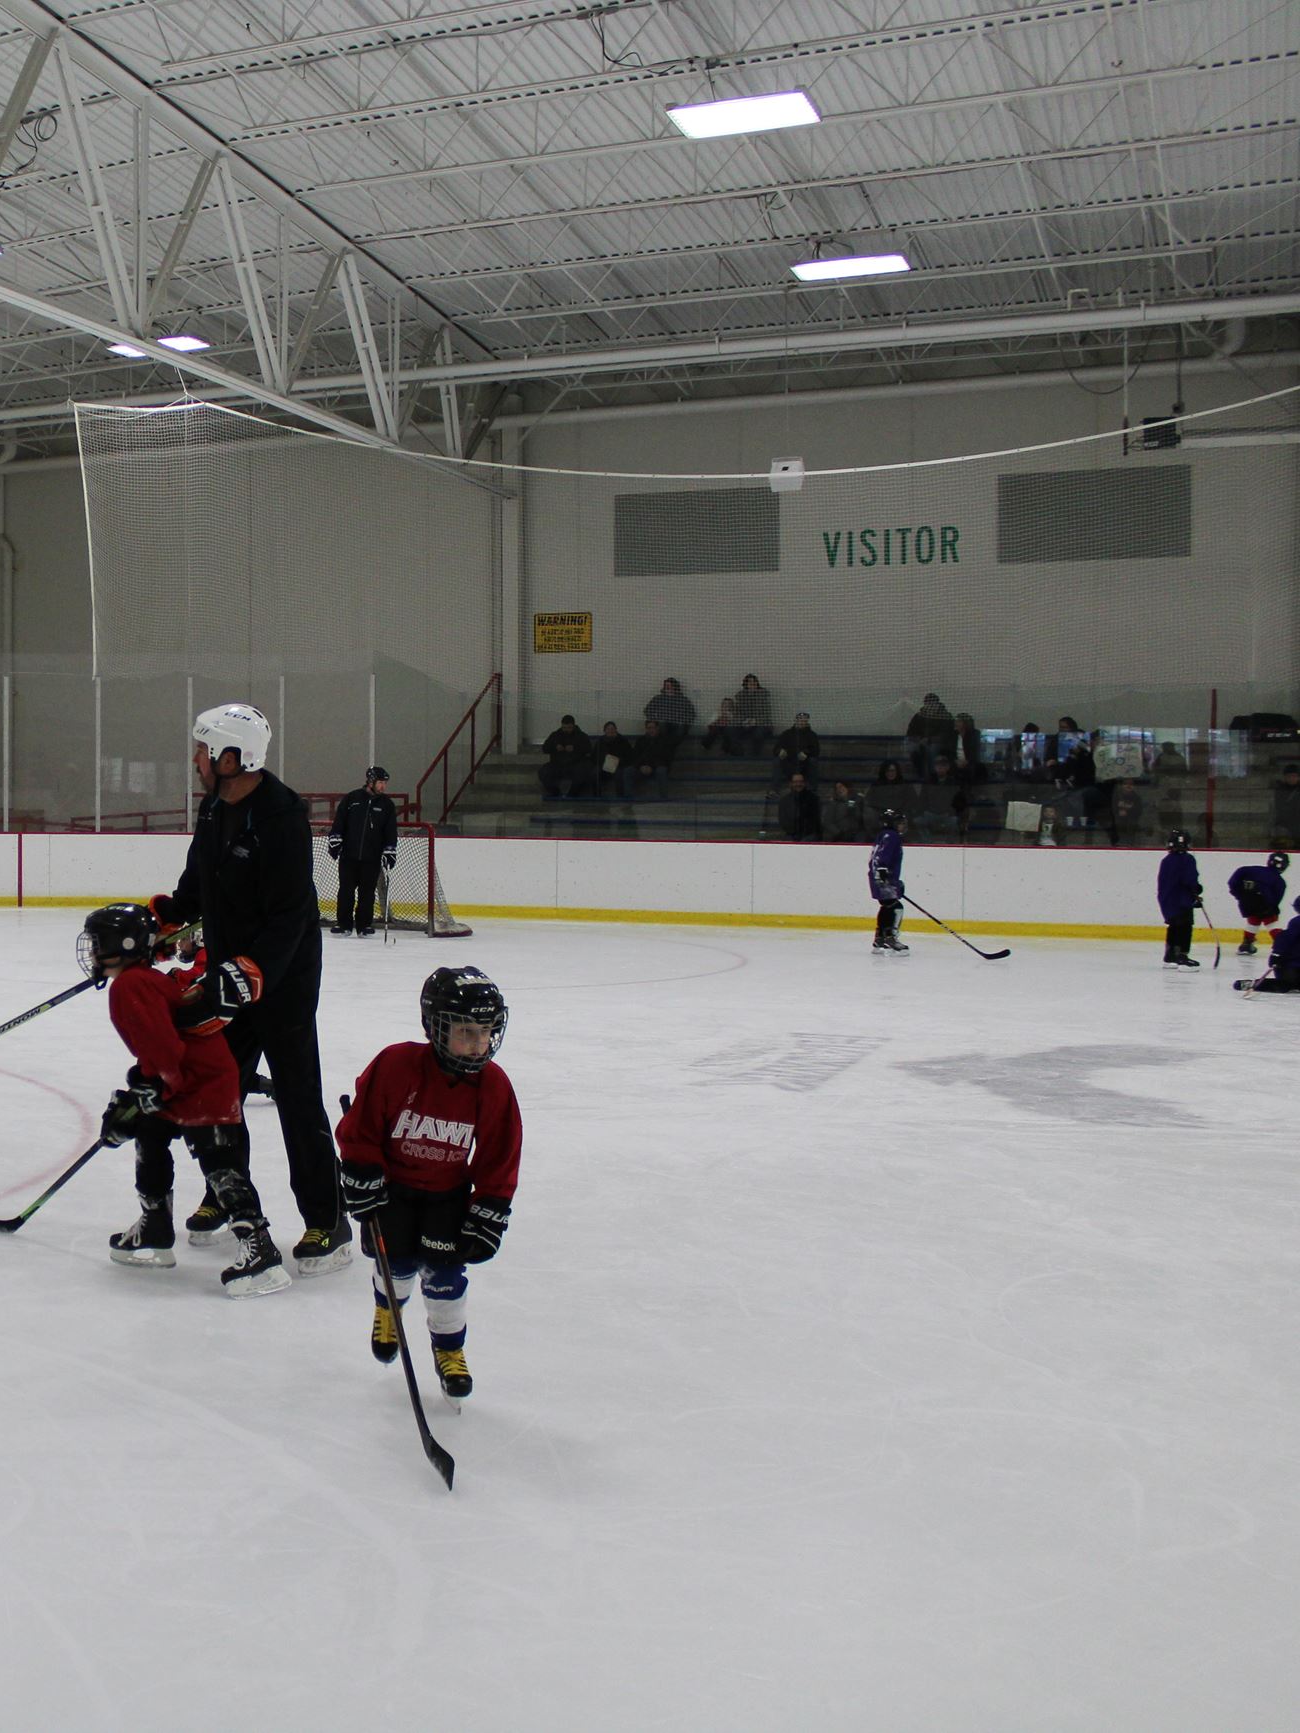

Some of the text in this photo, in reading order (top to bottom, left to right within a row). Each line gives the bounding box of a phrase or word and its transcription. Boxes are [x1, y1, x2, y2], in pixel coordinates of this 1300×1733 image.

[822, 525, 960, 568] VISITOR
[225, 711, 252, 721] CCM
[401, 1141, 445, 1162] CROSS
[421, 1235, 457, 1252] Reebok
